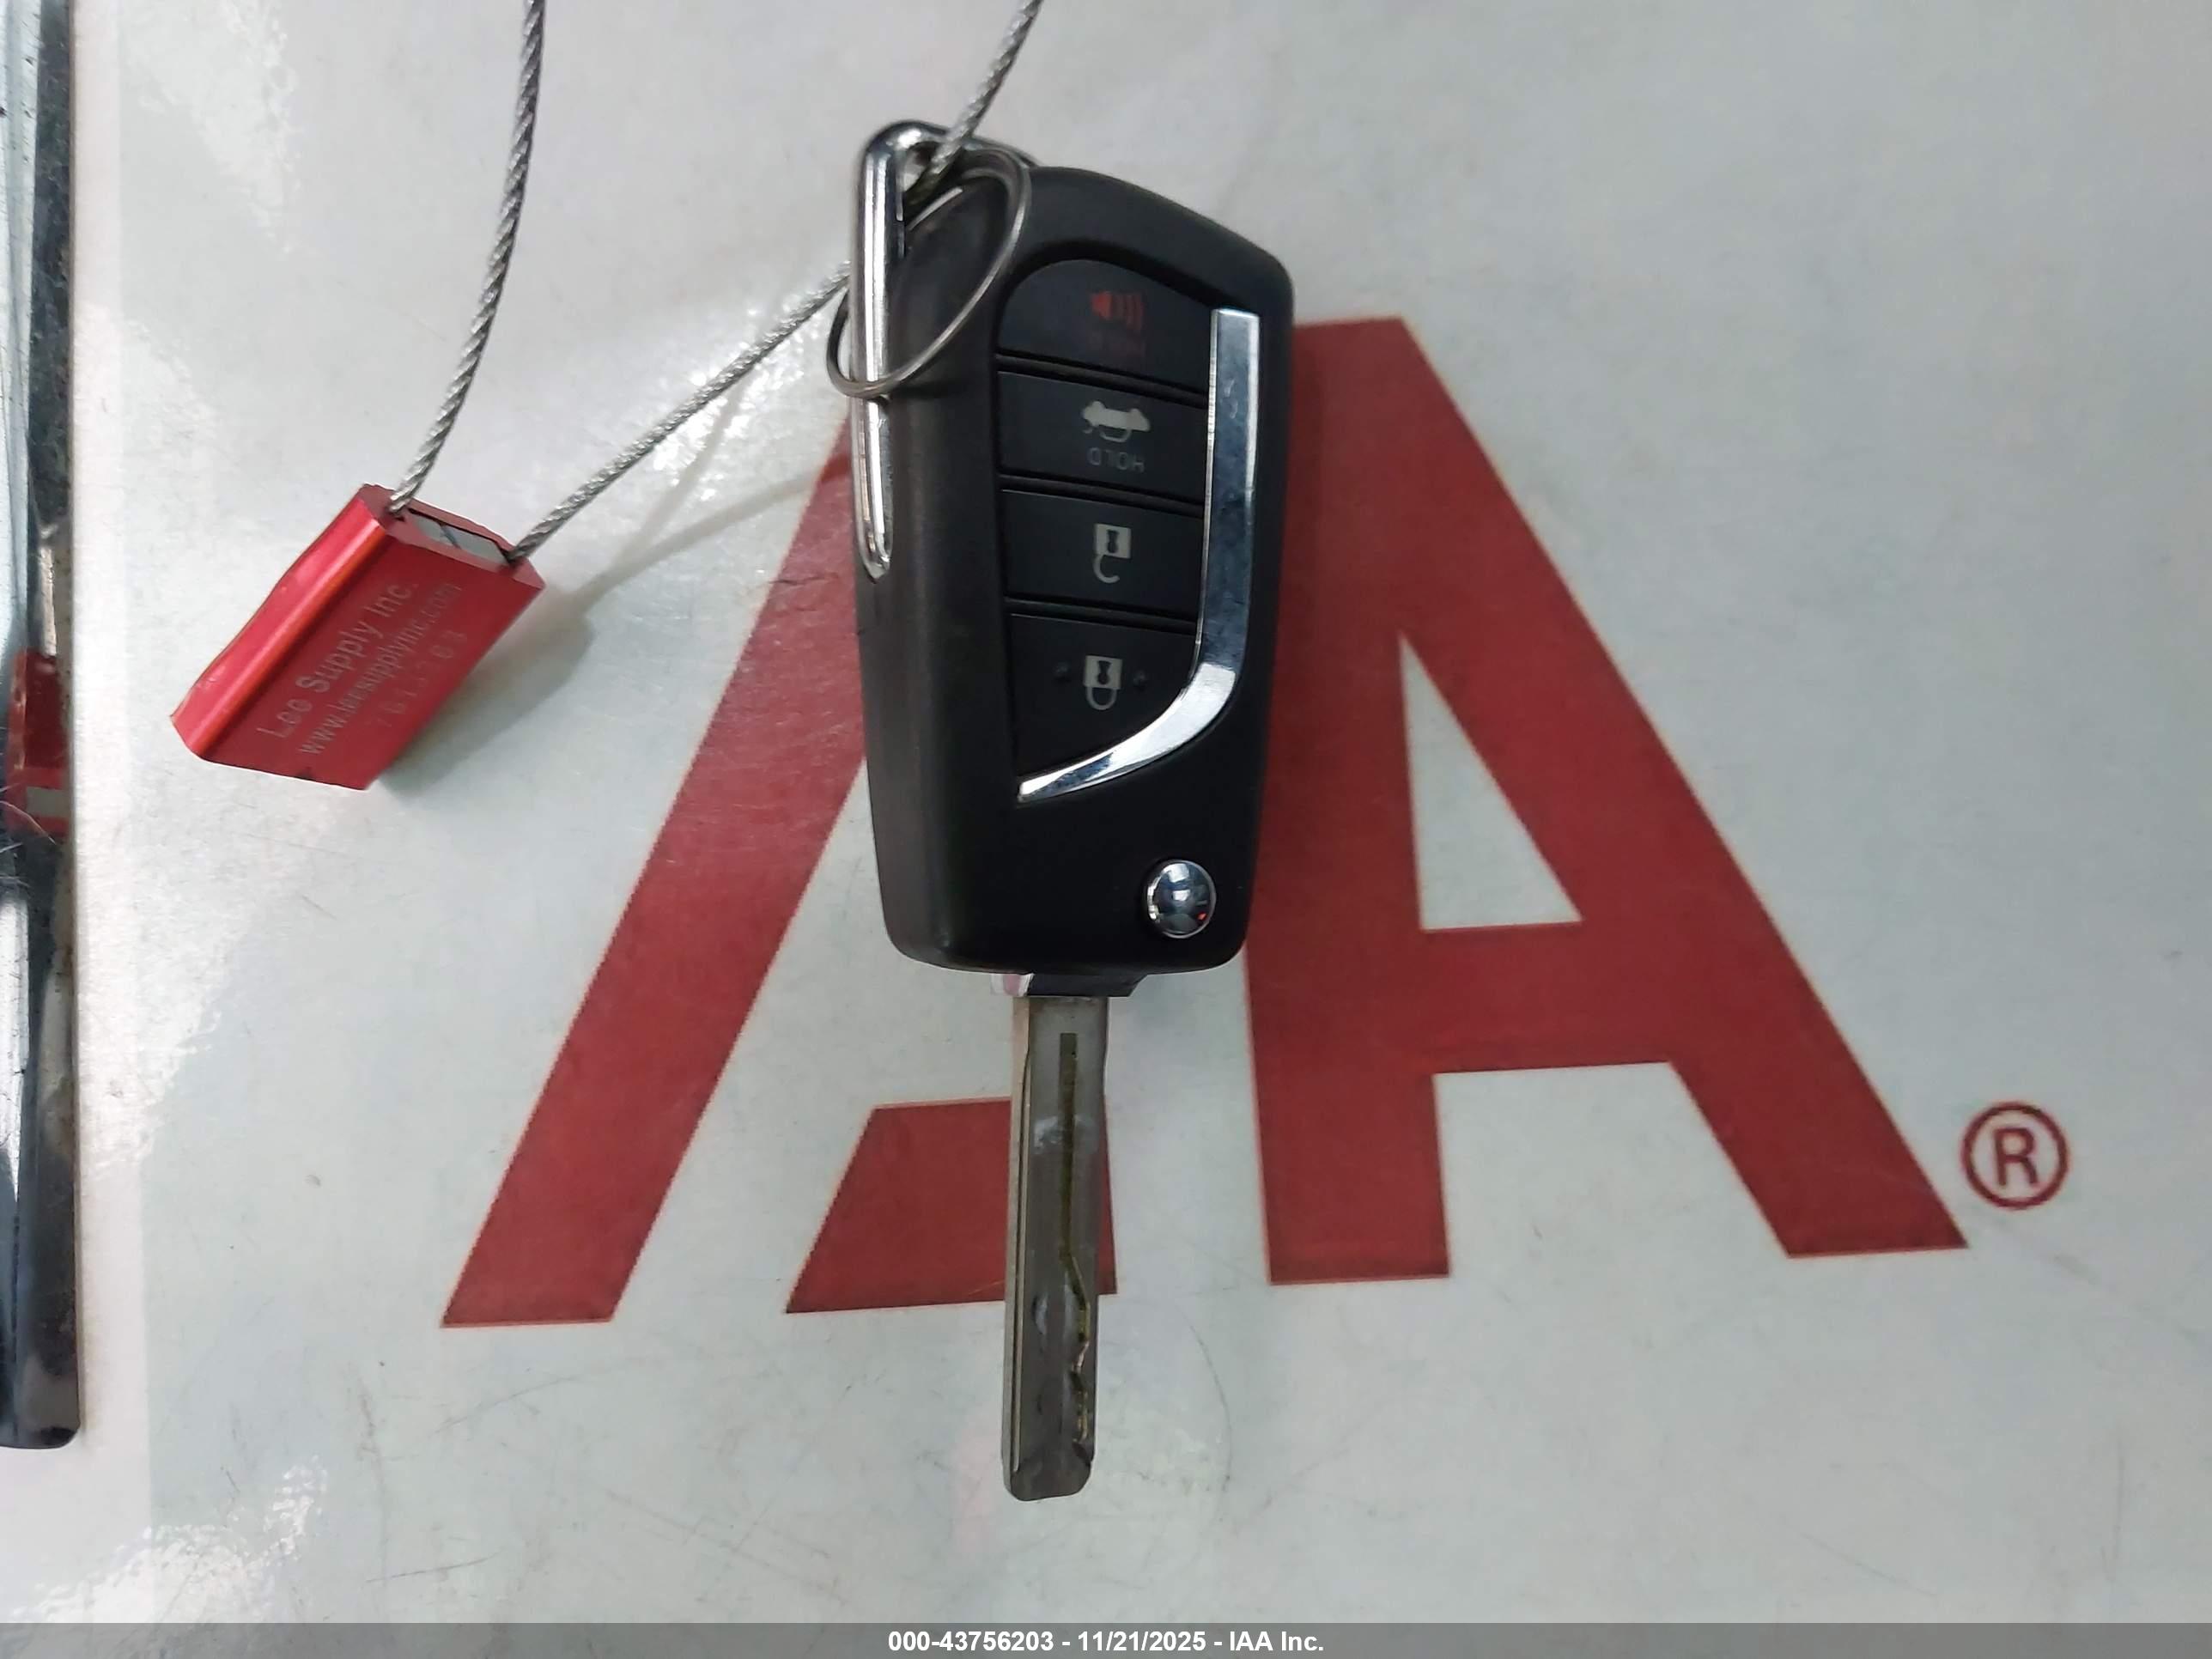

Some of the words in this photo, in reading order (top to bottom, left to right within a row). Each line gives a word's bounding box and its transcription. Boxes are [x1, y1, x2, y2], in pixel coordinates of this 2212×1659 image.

[1087, 447, 1145, 472] HOLD
[295, 619, 385, 694] Supply
[363, 584, 420, 619] Inc.
